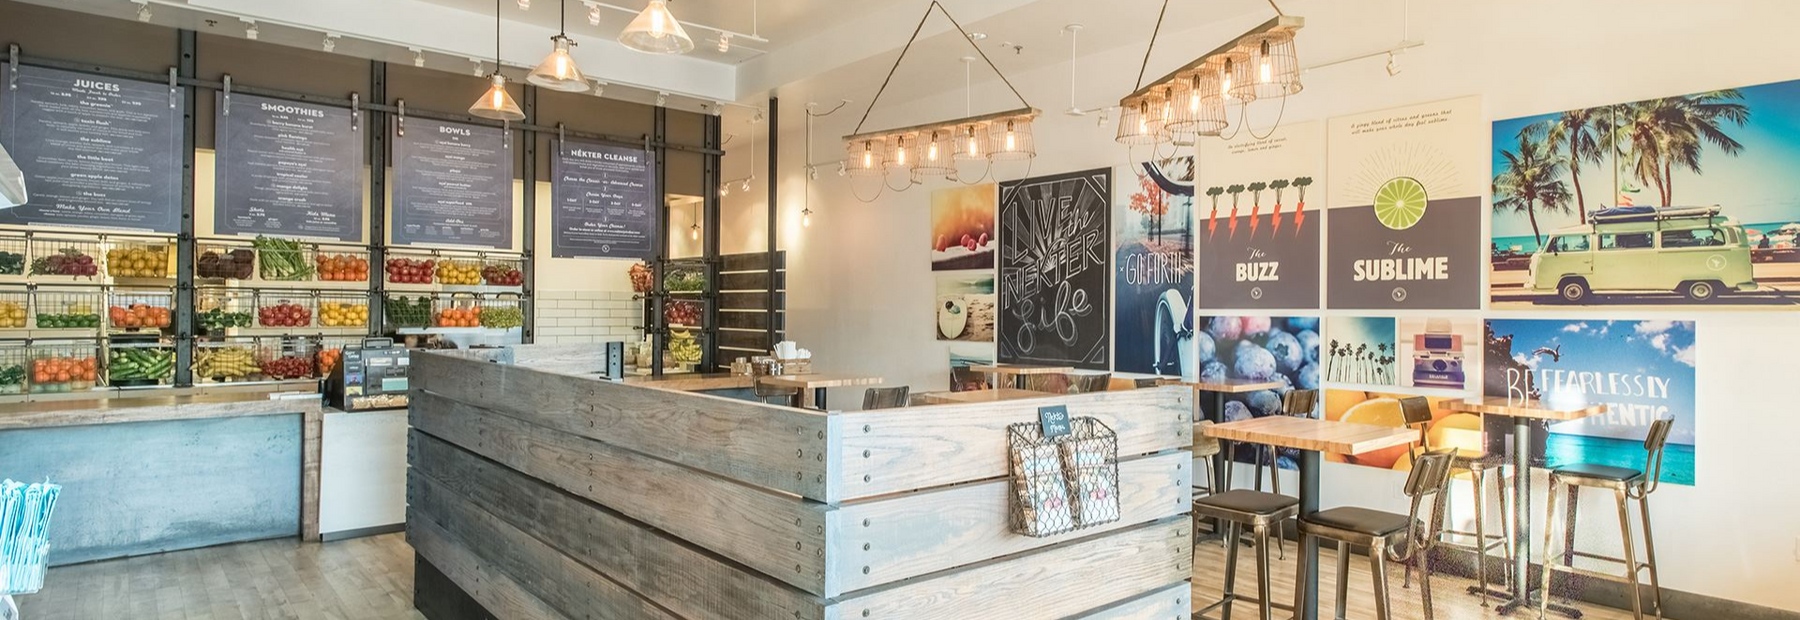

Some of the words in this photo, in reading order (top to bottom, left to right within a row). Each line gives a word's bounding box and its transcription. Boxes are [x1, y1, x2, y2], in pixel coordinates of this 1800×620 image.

[73, 79, 120, 92] JUICES
[261, 102, 324, 118] SMOOTHIES
[439, 125, 471, 136] BOWLS
[571, 149, 602, 159] NÉKTER
[604, 153, 638, 163] CLEANSE
[79, 204, 95, 212] Your
[1011, 195, 1074, 266] LIVE
[1061, 208, 1095, 237] the
[1246, 246, 1267, 260] The
[1385, 240, 1413, 256] The
[1004, 230, 1105, 310] NEKTER
[1126, 253, 1143, 285] GO
[1147, 251, 1182, 285] FORTH
[1235, 261, 1279, 282] BUZZ
[1353, 256, 1449, 282] SUBLIME
[1506, 367, 1538, 409] BE
[1540, 369, 1671, 399] FEARLESSLY
